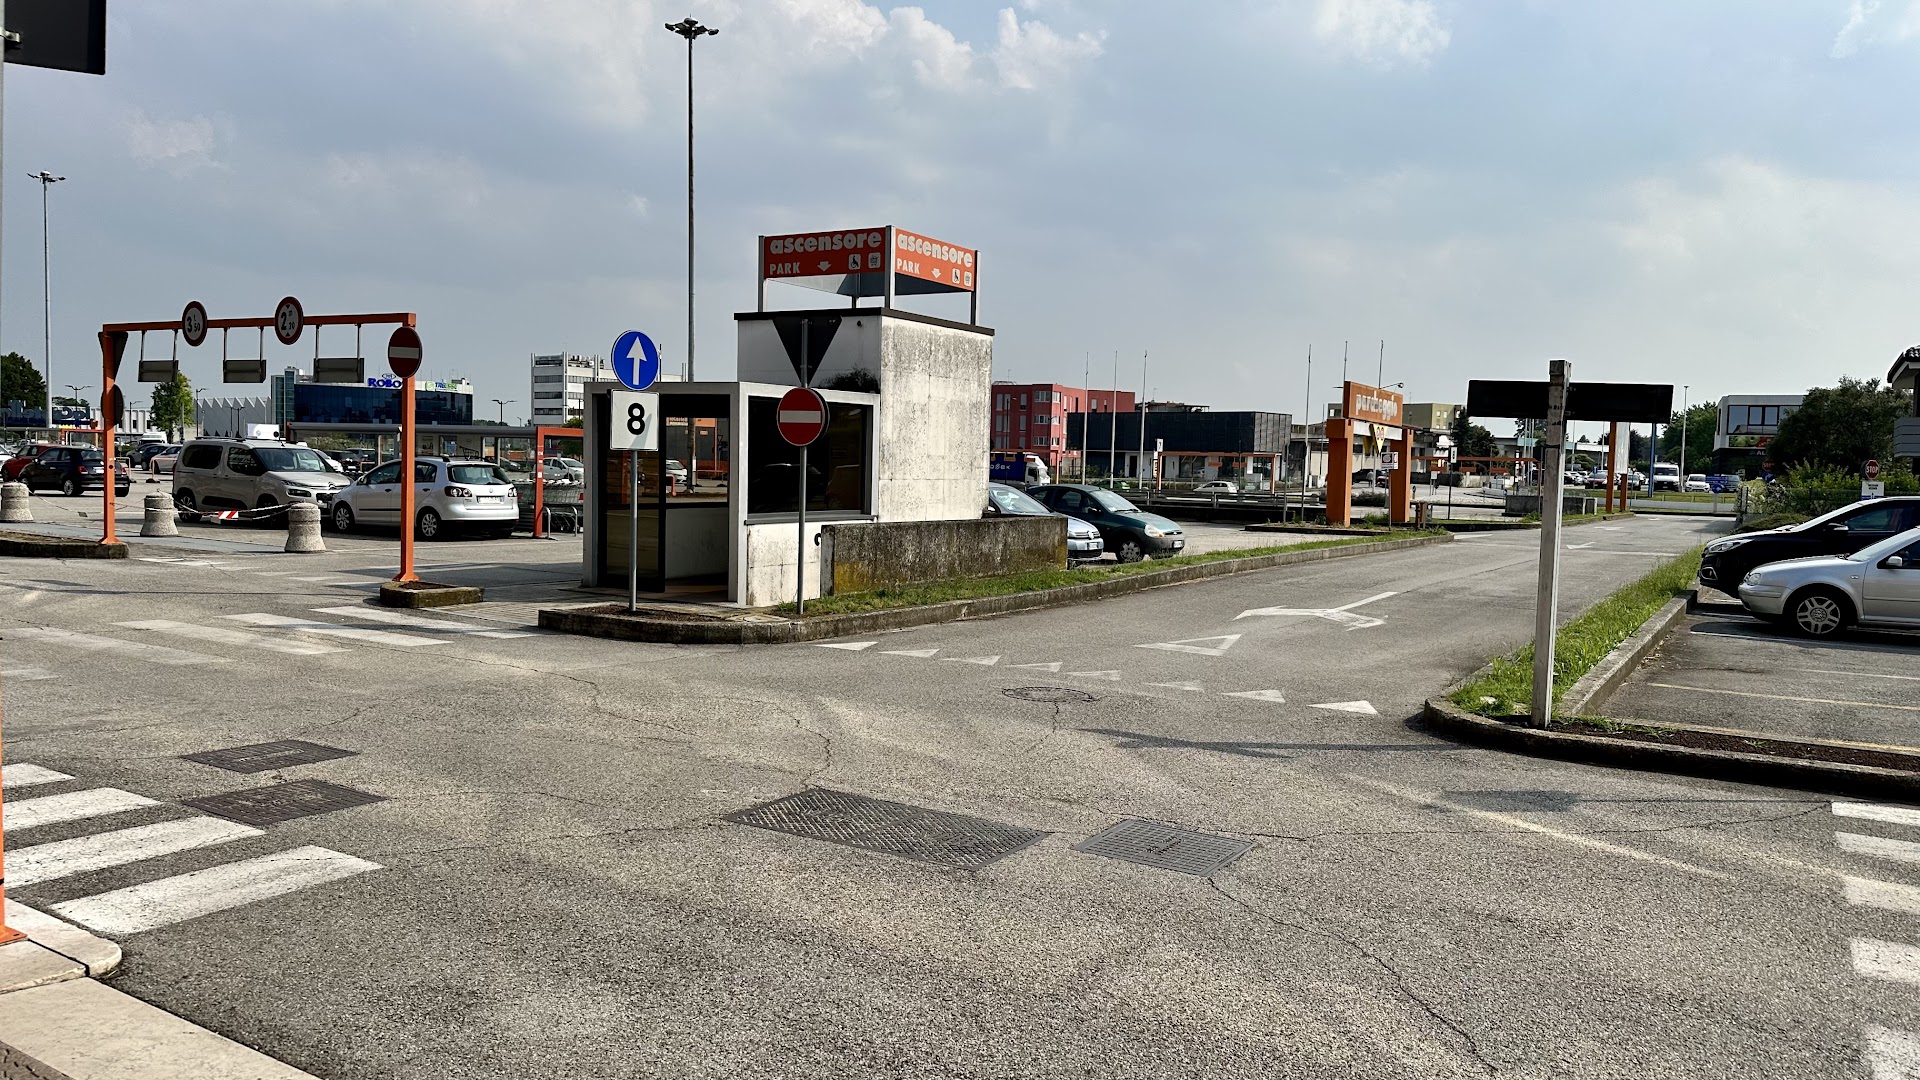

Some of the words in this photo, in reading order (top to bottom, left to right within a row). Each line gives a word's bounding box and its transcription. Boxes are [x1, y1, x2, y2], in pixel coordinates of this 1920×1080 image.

[770, 232, 882, 255] ascensore
[897, 233, 973, 268] ascensore
[769, 262, 800, 275] PARK
[897, 257, 920, 275] PARK
[187, 316, 193, 333] 3
[194, 323, 200, 332] 50
[281, 311, 287, 331] 2
[1355, 390, 1398, 421] parcheggio
[626, 402, 646, 435] 8
[1866, 466, 1879, 474] STOP
